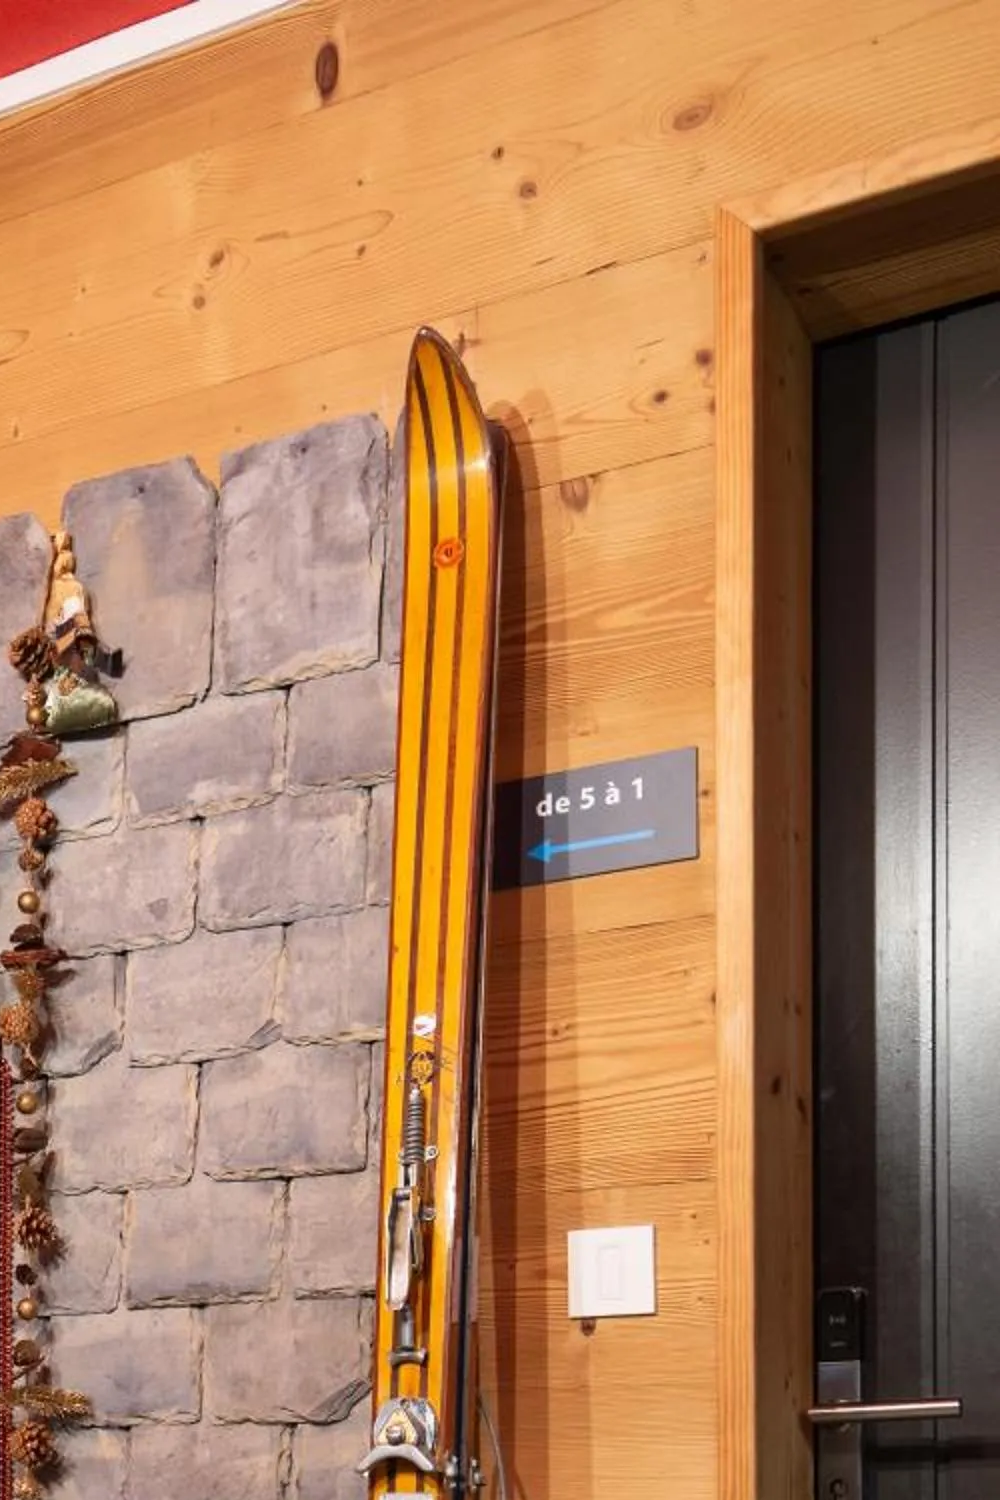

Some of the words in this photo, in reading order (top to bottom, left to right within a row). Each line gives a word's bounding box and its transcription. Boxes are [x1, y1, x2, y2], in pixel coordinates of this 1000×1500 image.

[536, 792, 571, 817] de
[579, 786, 596, 810] 5
[604, 782, 621, 805] à
[631, 777, 644, 799] 1
